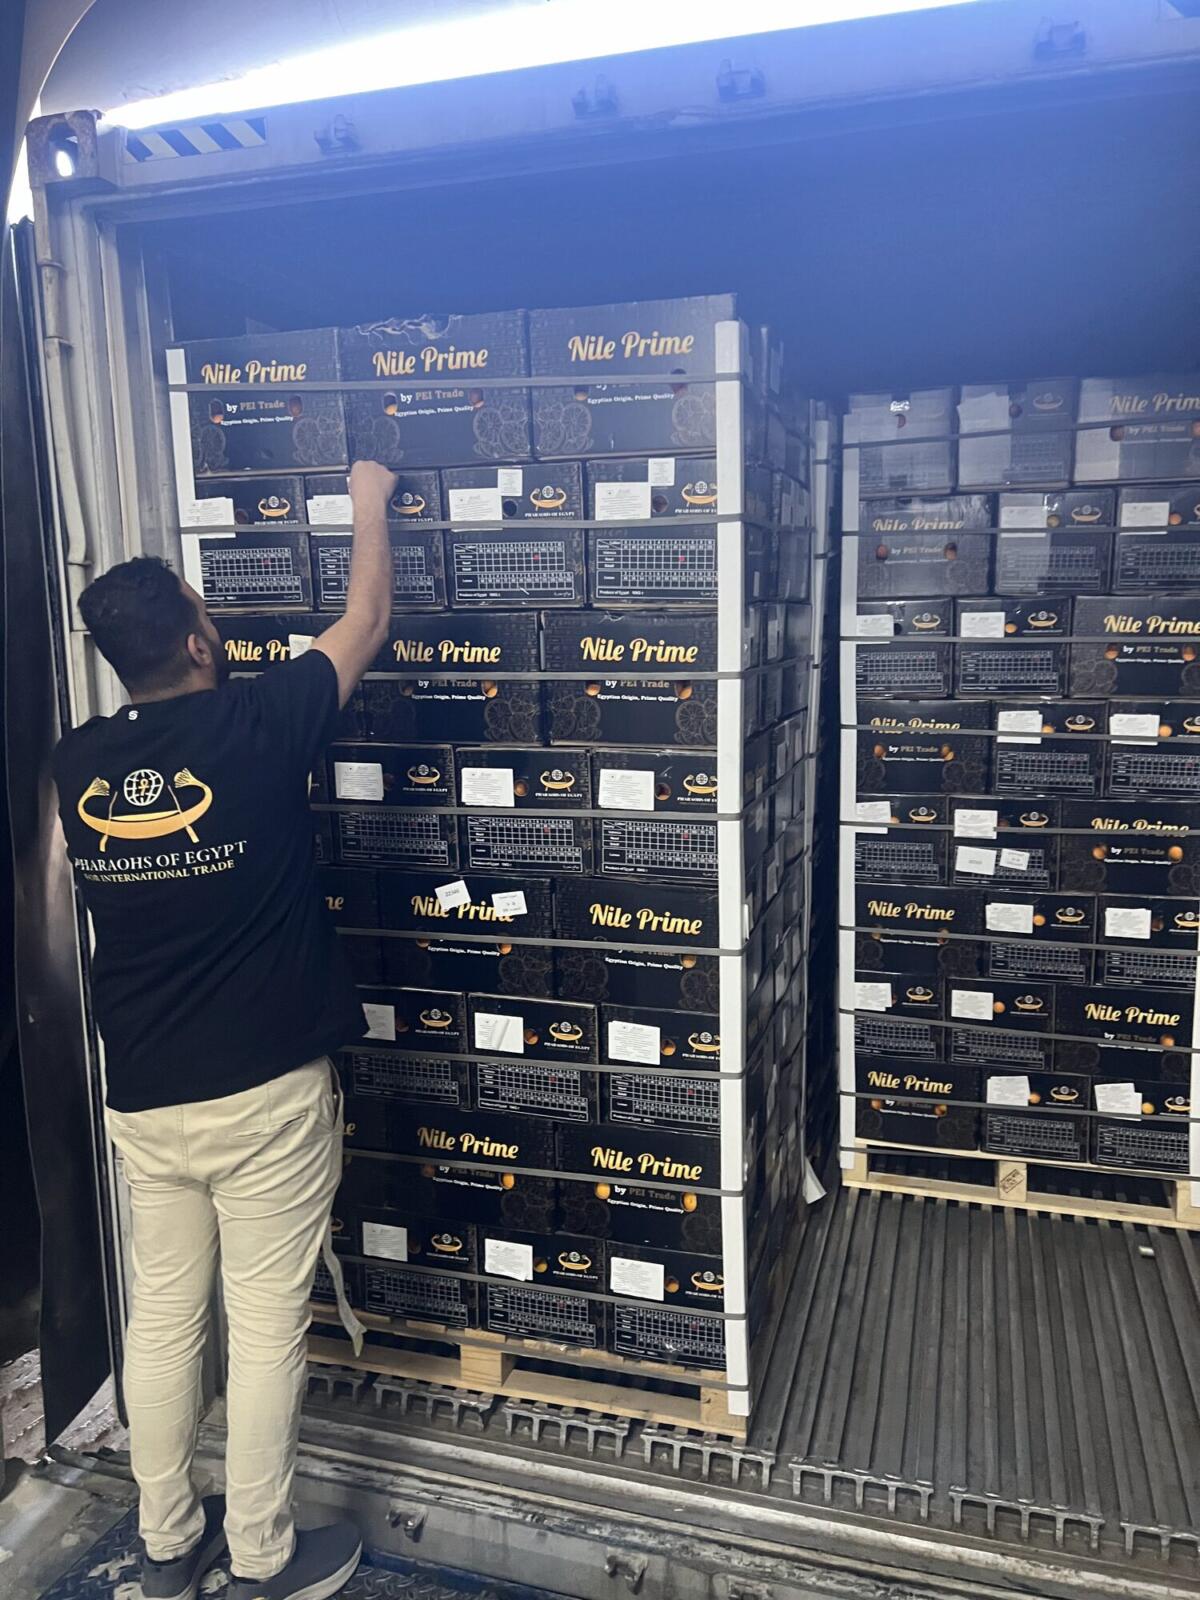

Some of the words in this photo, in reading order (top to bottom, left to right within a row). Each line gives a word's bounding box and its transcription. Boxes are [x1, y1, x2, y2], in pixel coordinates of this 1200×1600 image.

[568, 335, 616, 362] Nile
[621, 331, 694, 358] Prime
[201, 362, 241, 384] Nile
[245, 360, 307, 384] Prime
[373, 350, 416, 377] Nile
[420, 345, 489, 373] Prime
[400, 393, 412, 404] by
[435, 388, 464, 399] Trade
[1108, 394, 1148, 413] Nile
[1152, 393, 1200, 412] Prim
[226, 403, 238, 413] by
[1103, 614, 1142, 633] Nile
[224, 639, 262, 661] Nile
[393, 639, 434, 662] Nile
[438, 640, 501, 663] Prime
[580, 636, 624, 661] Nile
[629, 637, 698, 663] Prime
[1123, 645, 1134, 654] by
[418, 680, 429, 688] by
[605, 680, 617, 688] by
[641, 680, 670, 688] Trade
[889, 745, 899, 753] by
[75, 855, 152, 872] PHARAOHS
[156, 853, 180, 867] OF
[184, 840, 247, 864] EGYPT
[1111, 847, 1122, 855] by
[100, 868, 190, 883] INTERNATIONAL
[192, 859, 235, 876] TRADE
[589, 903, 632, 929] Nile
[636, 908, 702, 935] Prime
[867, 900, 901, 918] Nile
[904, 902, 955, 920] Prime
[1084, 1003, 1121, 1022] Nile
[1125, 1006, 1180, 1026] Prime
[867, 1071, 900, 1089] Nile
[904, 1075, 953, 1094] Prime
[417, 1127, 455, 1150] Nile
[459, 1132, 519, 1159] Prime
[591, 1146, 633, 1172] Nile
[638, 1153, 702, 1180] Prime
[614, 1185, 626, 1195] by
